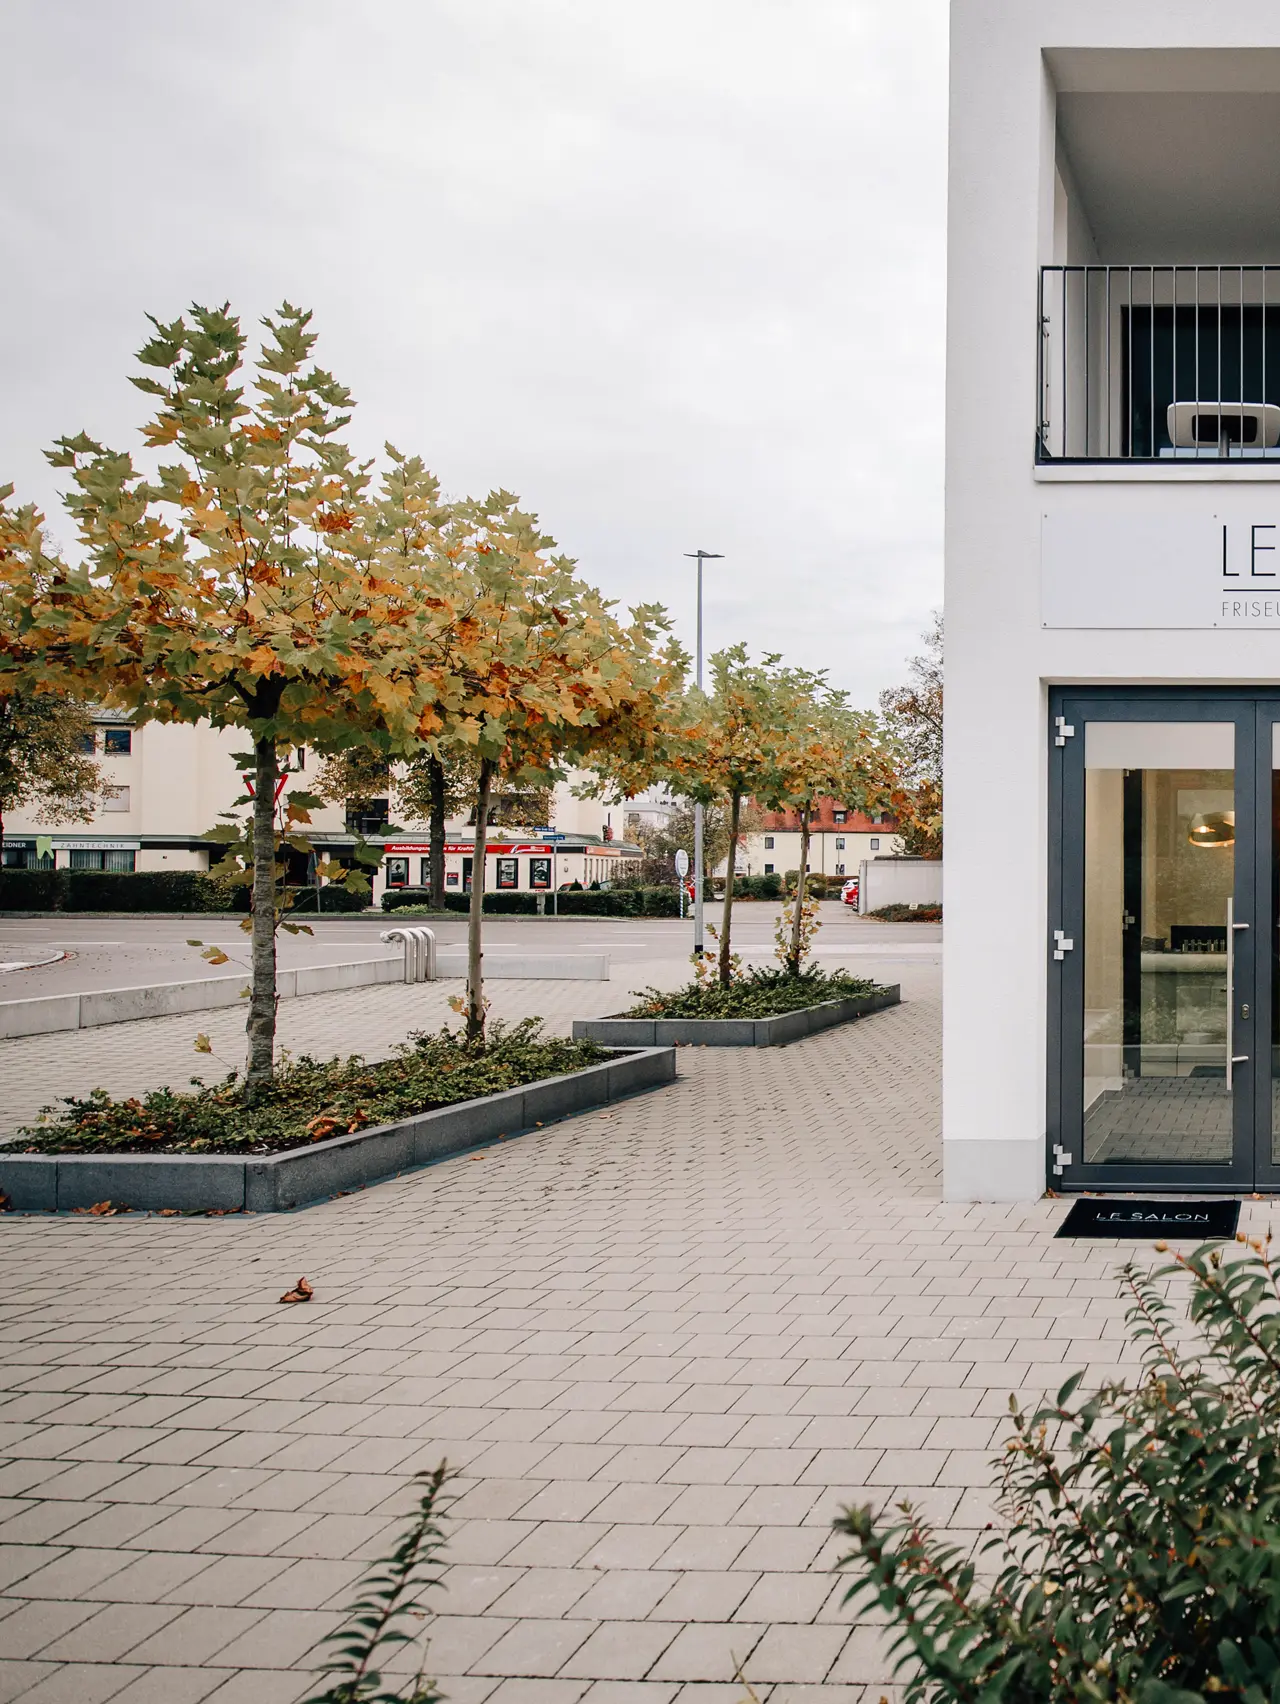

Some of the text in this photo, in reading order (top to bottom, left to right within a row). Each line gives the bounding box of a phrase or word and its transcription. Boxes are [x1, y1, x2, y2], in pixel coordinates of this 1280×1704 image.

[1222, 525, 1276, 577] LE
[1096, 1212, 1209, 1221] LE SALON
